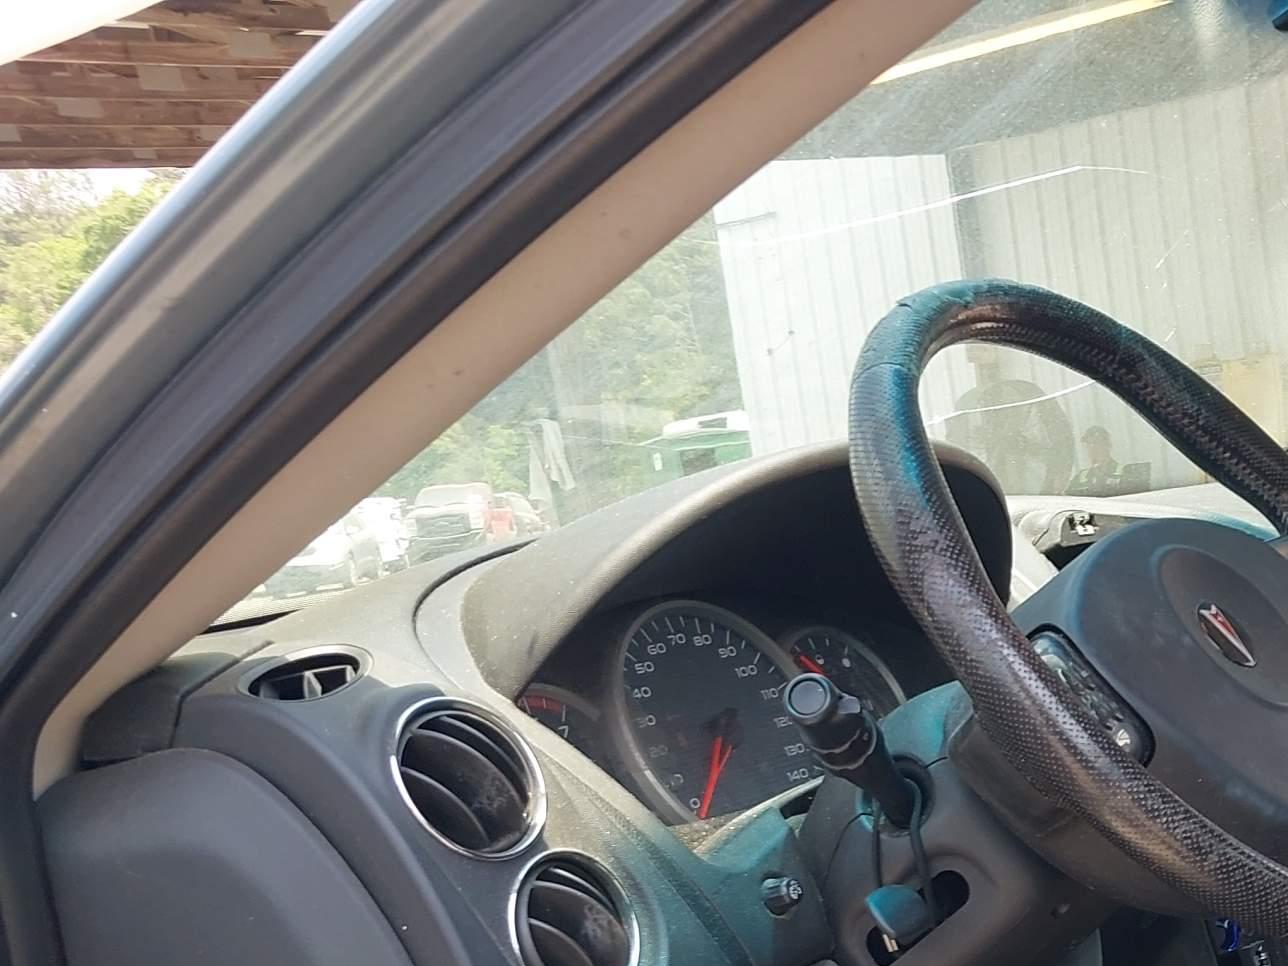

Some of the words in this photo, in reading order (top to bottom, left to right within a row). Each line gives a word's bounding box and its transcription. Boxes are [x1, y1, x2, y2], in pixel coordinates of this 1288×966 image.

[666, 632, 686, 646] 70
[692, 634, 712, 647] 80
[647, 642, 667, 656] 60
[718, 646, 737, 658] 90
[634, 661, 655, 675] 50
[734, 664, 758, 679] 100
[633, 686, 652, 699] 40
[760, 687, 779, 700] 110
[784, 742, 805, 756] 130
[786, 768, 809, 782] 140
[689, 797, 701, 809] 0
